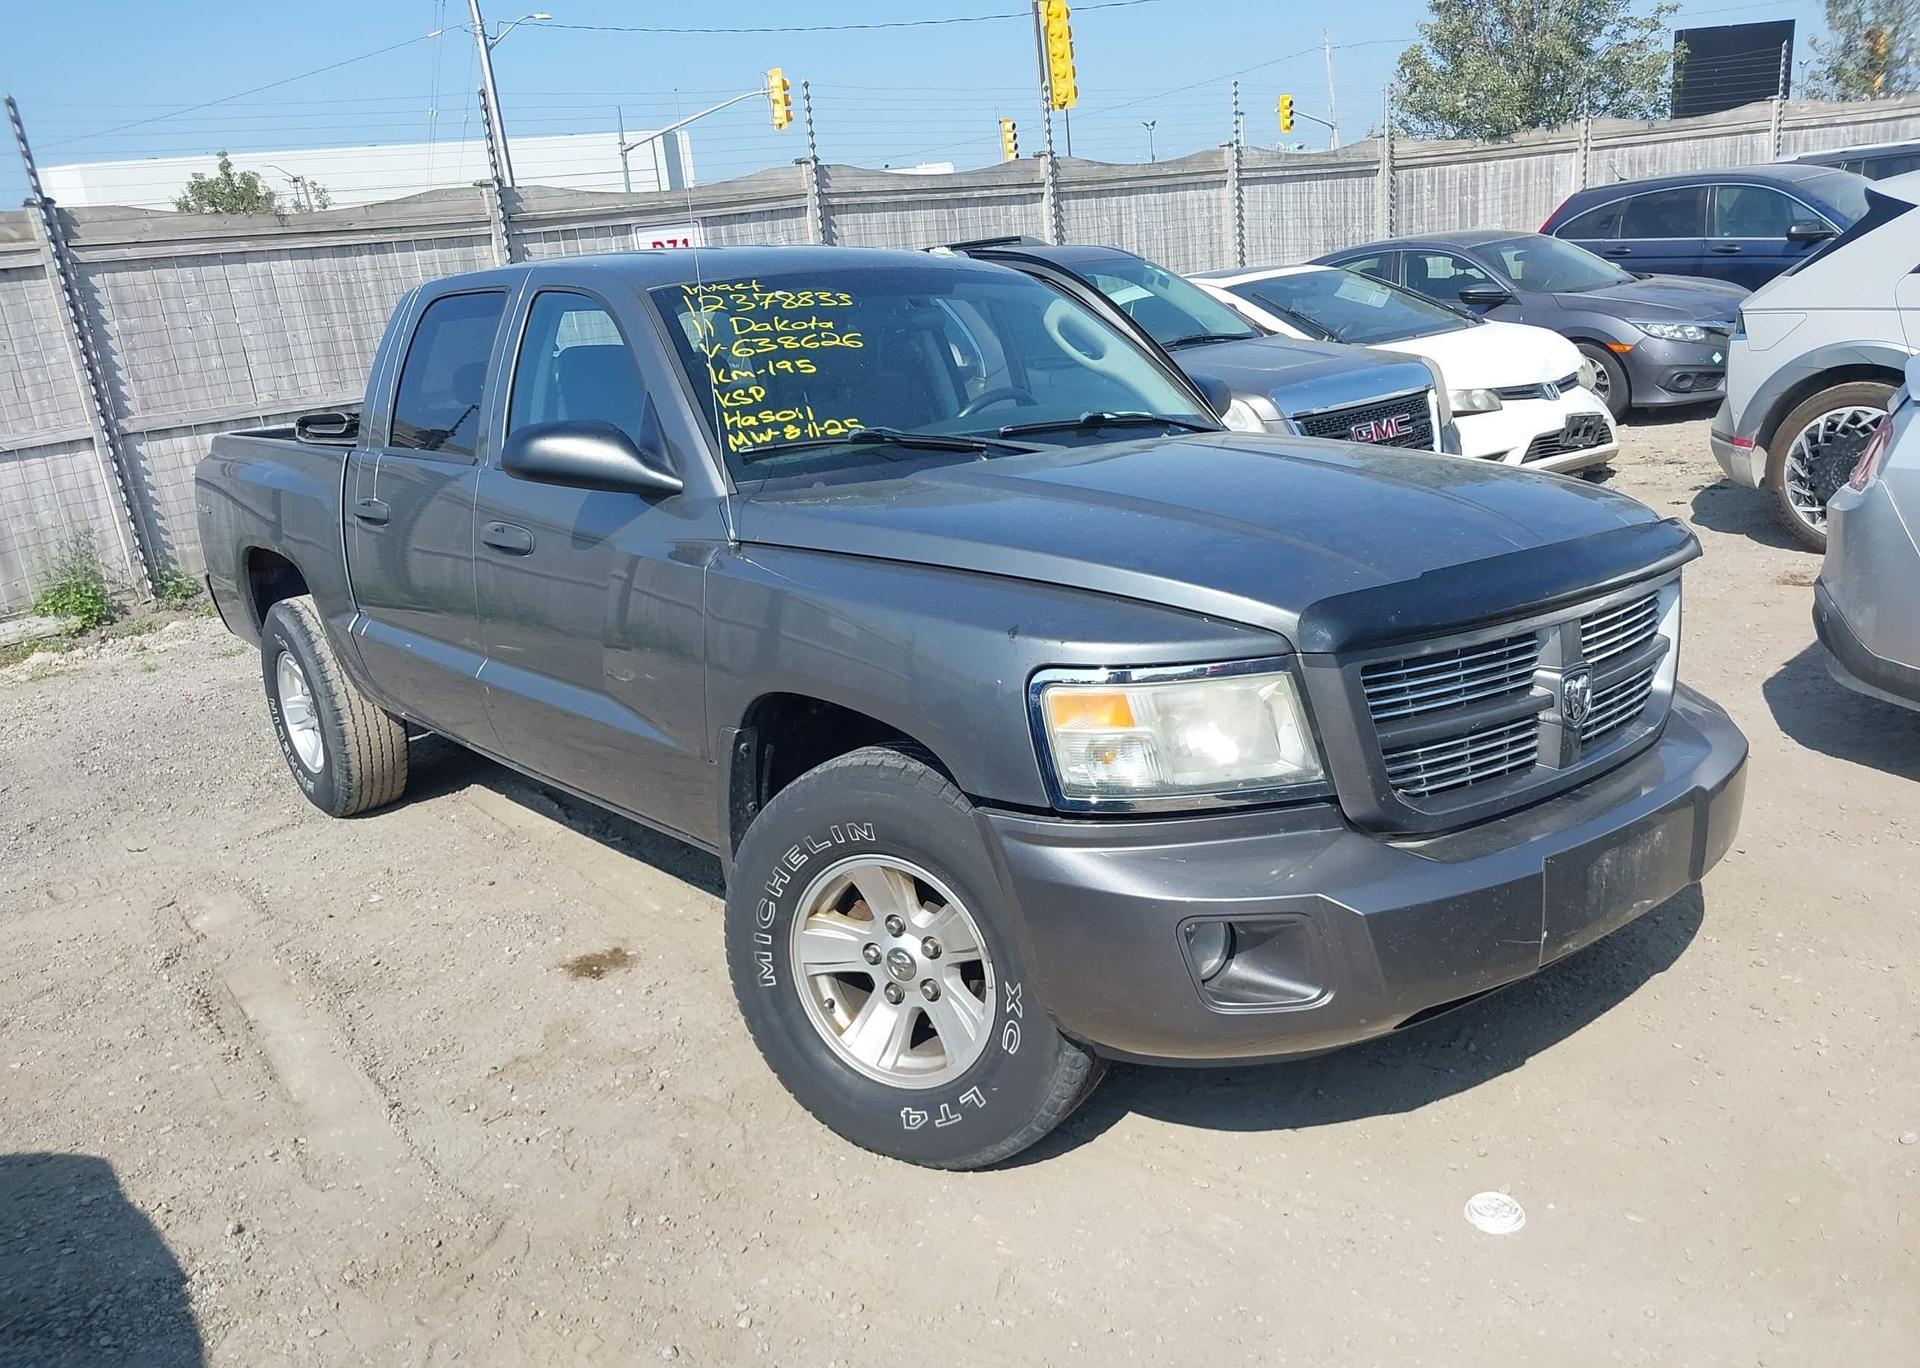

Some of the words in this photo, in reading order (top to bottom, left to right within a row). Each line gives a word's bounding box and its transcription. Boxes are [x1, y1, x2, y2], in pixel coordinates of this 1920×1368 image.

[683, 291, 853, 317] 12378833
[729, 316, 834, 335] Dakota
[714, 386, 766, 408] KSP
[1351, 414, 1414, 443] GMC
[754, 822, 876, 987] MICHELIN
[1002, 981, 1024, 1055] XC
